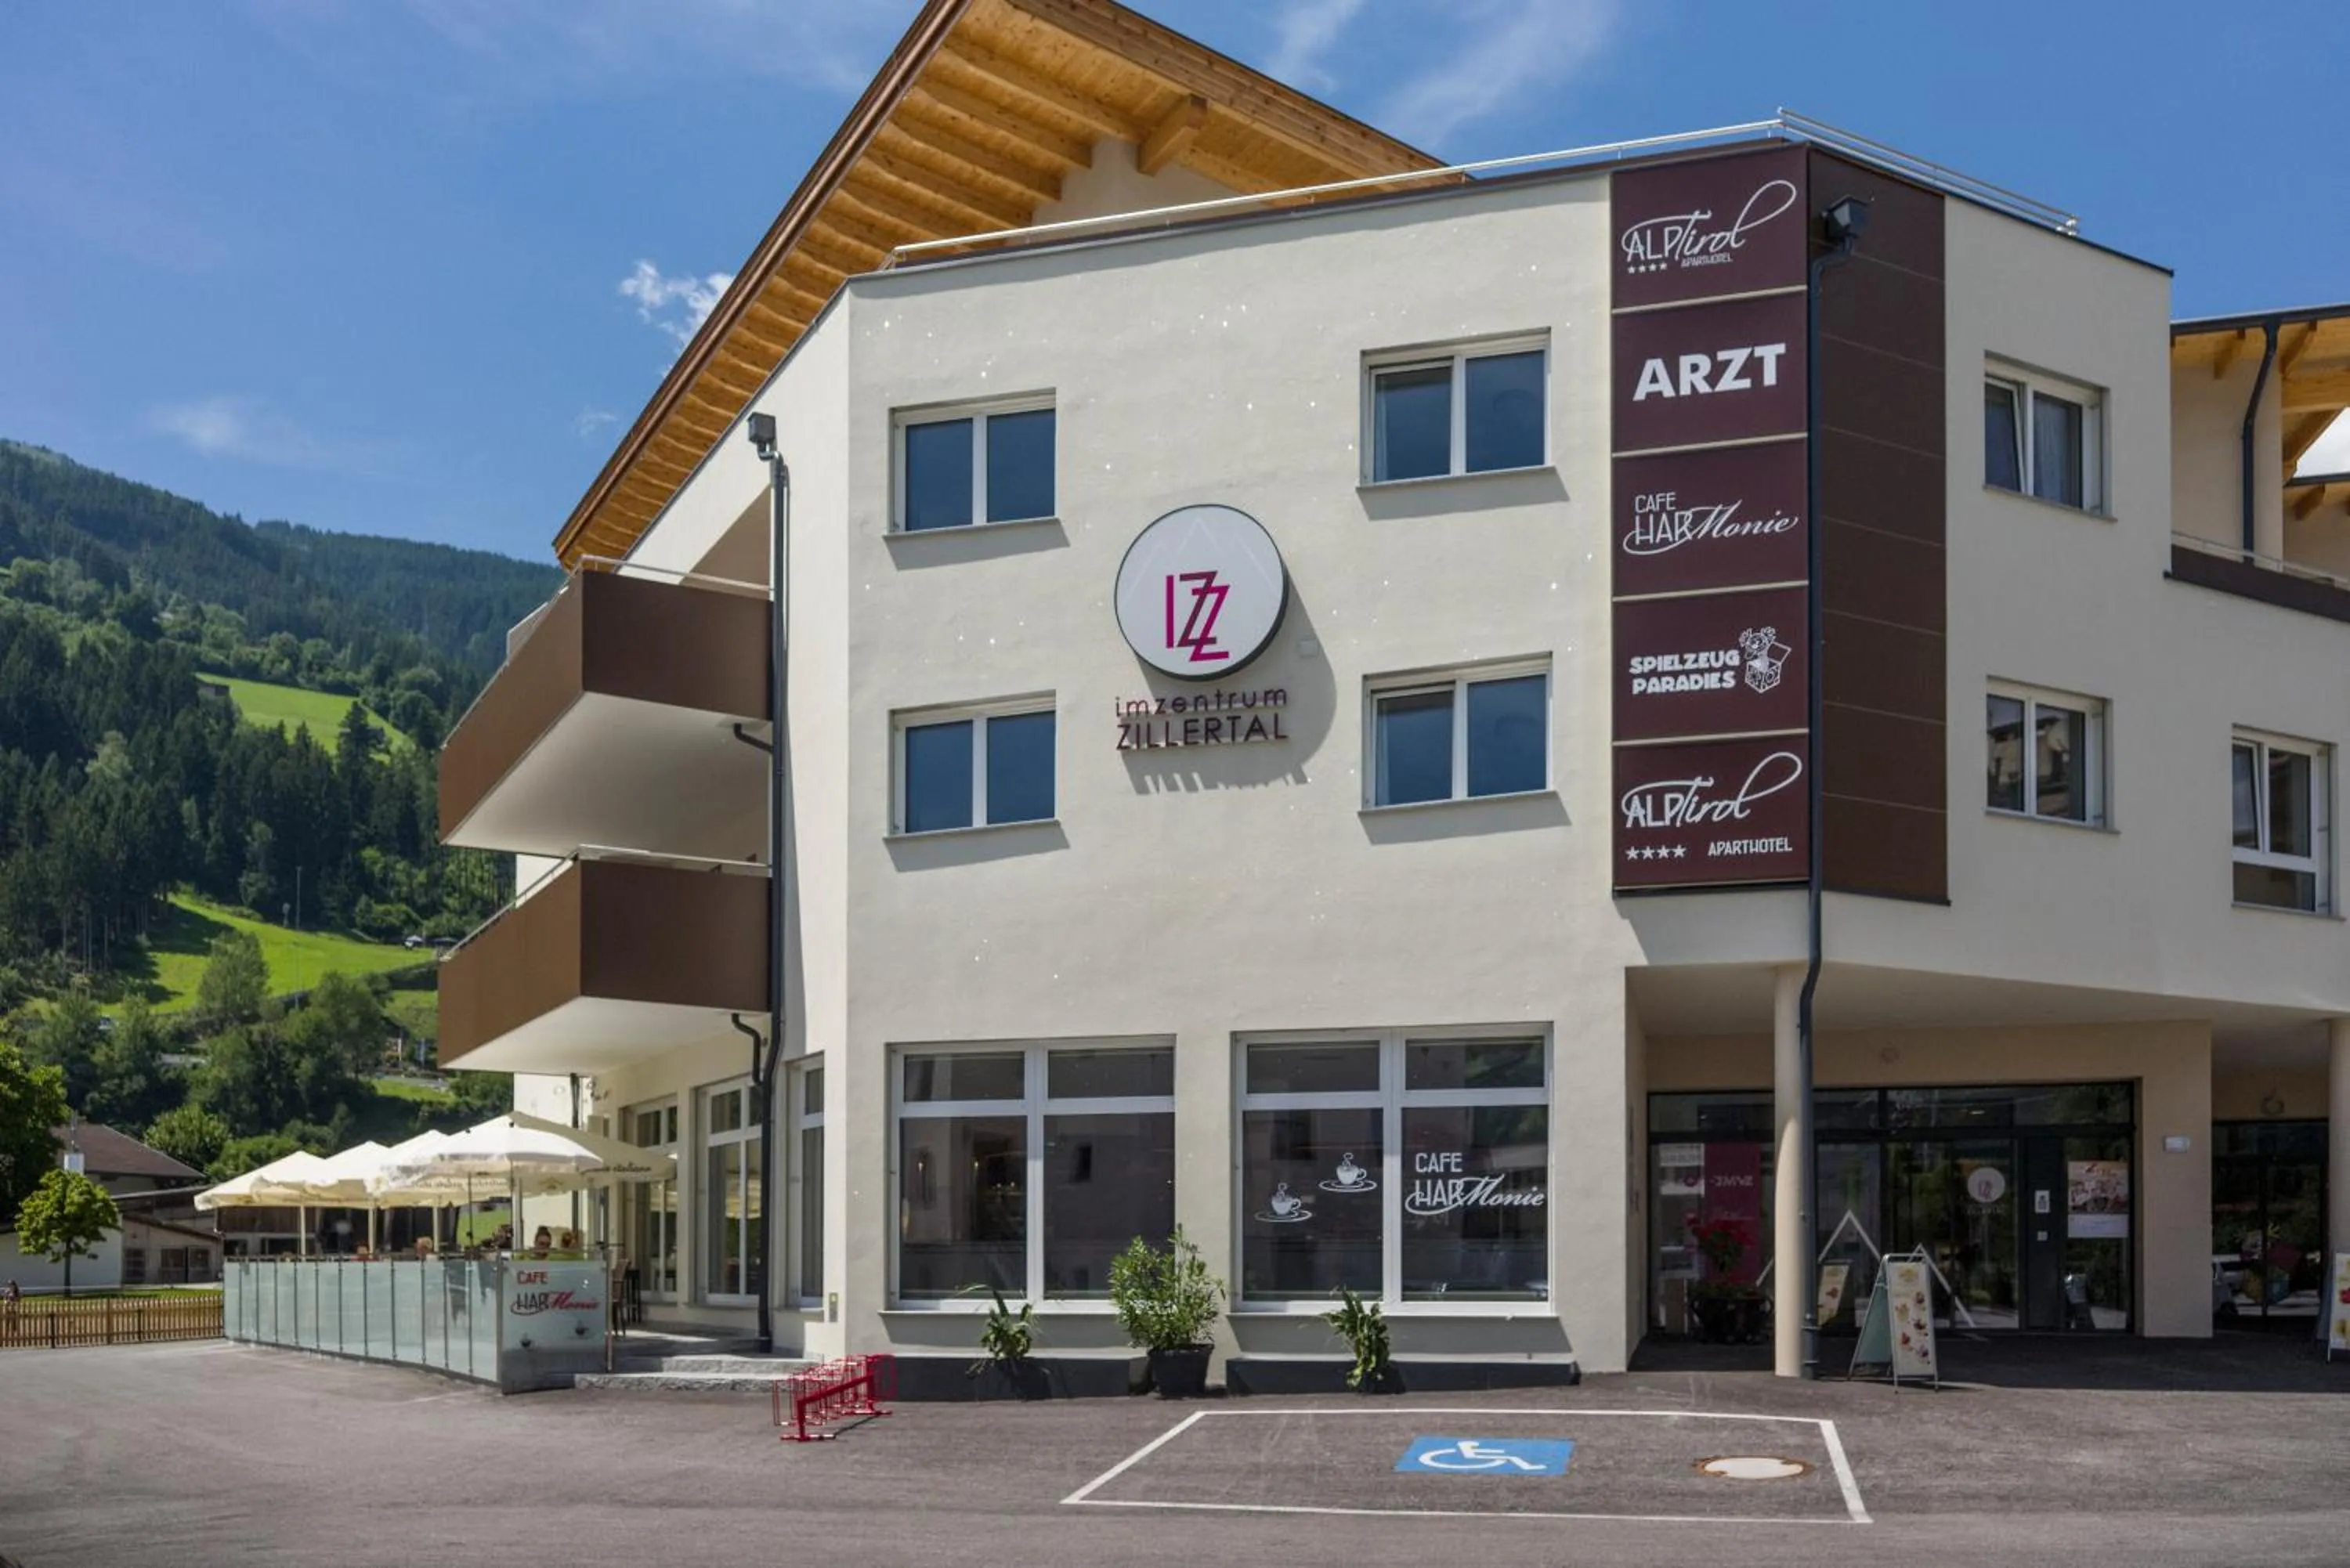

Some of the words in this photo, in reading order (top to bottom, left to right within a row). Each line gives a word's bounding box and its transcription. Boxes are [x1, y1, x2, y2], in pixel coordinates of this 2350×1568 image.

[1632, 342, 1786, 402] ARZT
[1634, 491, 1677, 514] CAFE
[1629, 649, 1741, 674] SPIELZEUG
[1632, 670, 1737, 695] PARADIES
[1115, 711, 1289, 750] ZILLERTAL
[1707, 836, 1793, 858] APARTHOTEL
[1415, 1152, 1463, 1172] CAFE
[516, 1270, 548, 1285] CAFE
